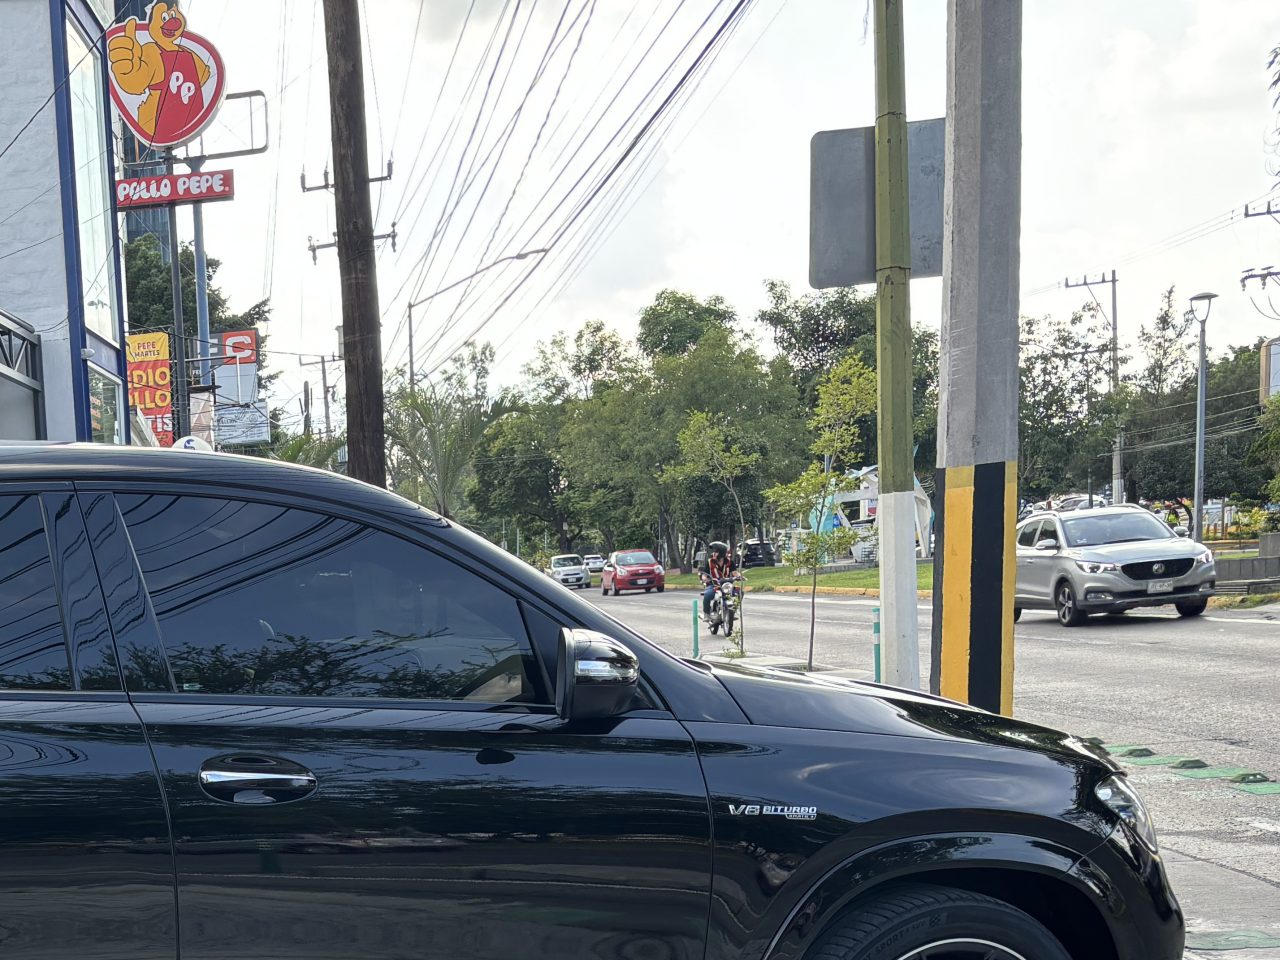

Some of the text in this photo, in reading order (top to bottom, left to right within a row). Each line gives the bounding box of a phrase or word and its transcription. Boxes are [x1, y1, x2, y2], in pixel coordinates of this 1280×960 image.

[169, 71, 196, 105] PP
[117, 174, 225, 202] POLLO PEPE
[137, 341, 157, 350] PEPE
[134, 349, 160, 358] MARTES
[728, 804, 817, 815] V8 BITURBO
